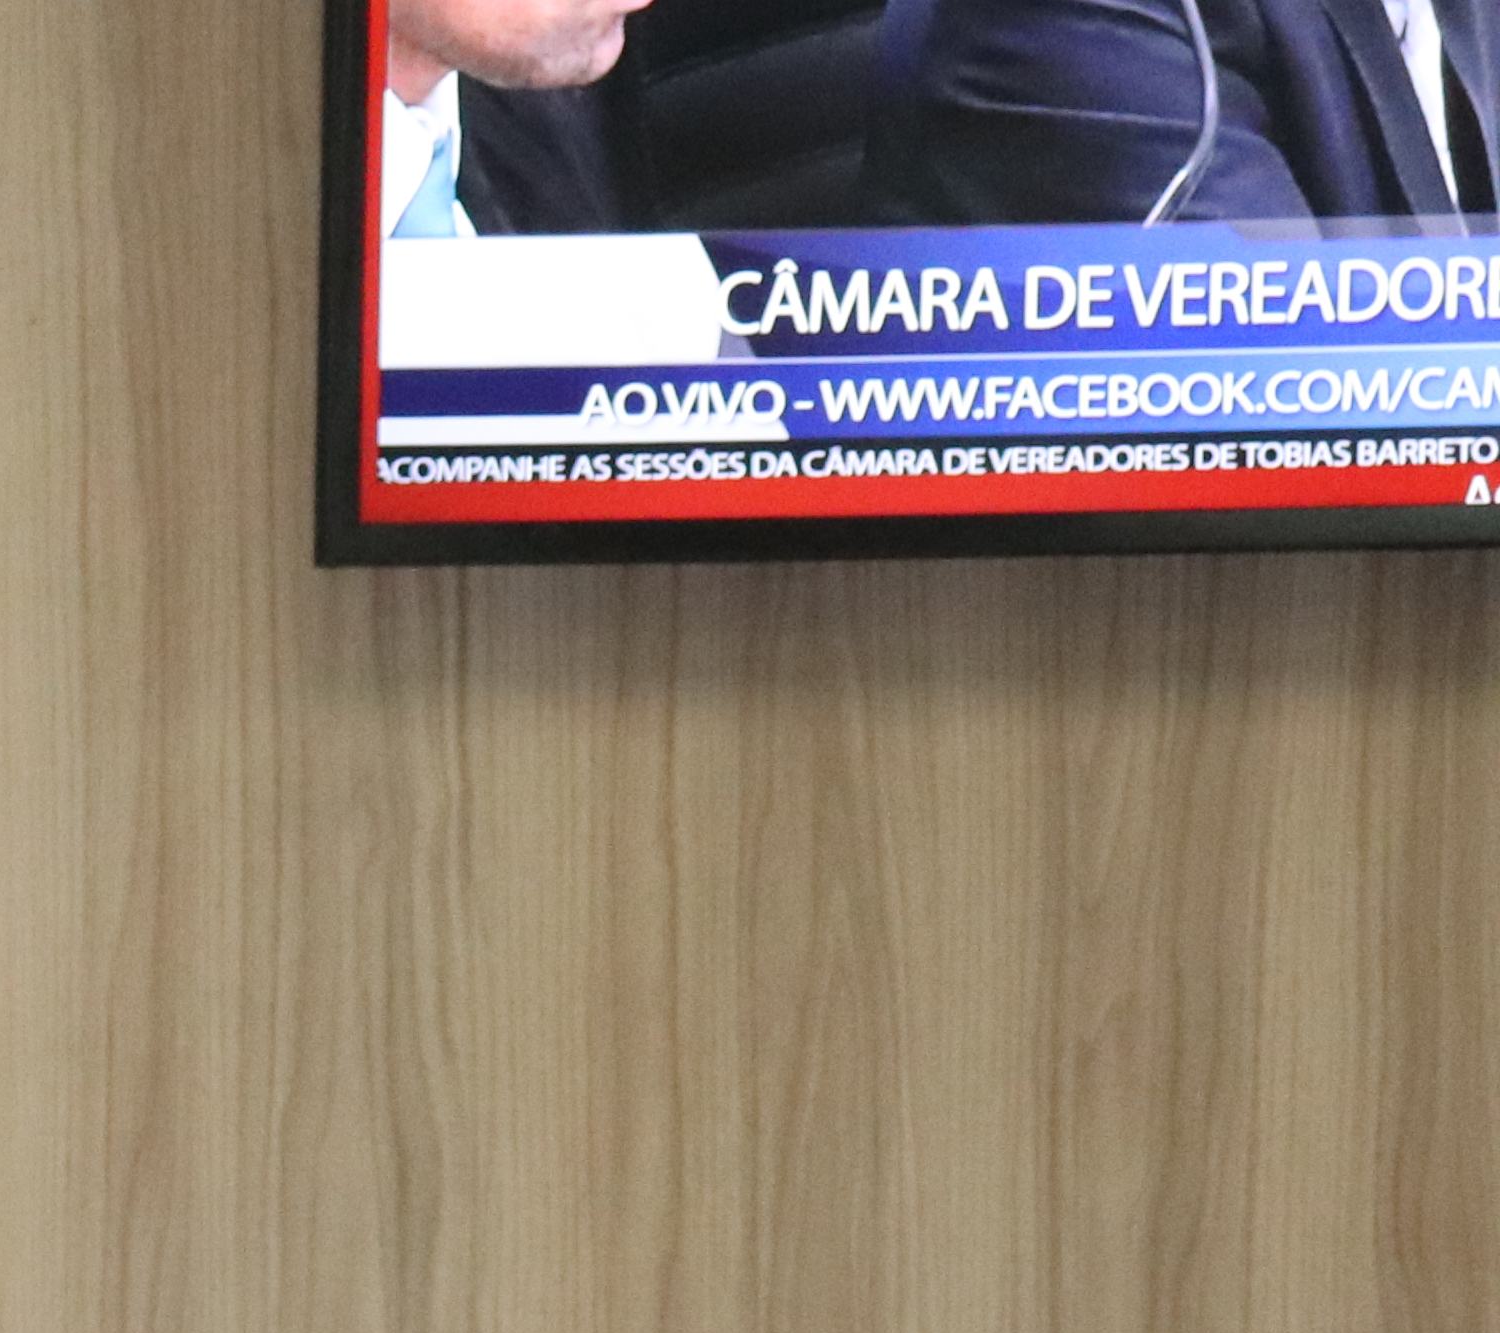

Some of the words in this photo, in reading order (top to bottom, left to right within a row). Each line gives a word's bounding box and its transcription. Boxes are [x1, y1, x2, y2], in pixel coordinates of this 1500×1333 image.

[718, 258, 1009, 336] CÂMARA
[1023, 264, 1115, 330] DE
[578, 382, 658, 426] AO
[661, 380, 787, 424] VIVO
[570, 452, 611, 481] AS
[615, 448, 747, 480] SESSÕES
[751, 450, 797, 477] DA
[802, 445, 937, 477] CÂMARA
[943, 446, 987, 474] DE
[988, 442, 1188, 474] VEREADORES
[1194, 441, 1238, 471] DE
[1240, 439, 1351, 469] TOBIAS
[1357, 436, 1499, 466] BARRETO
